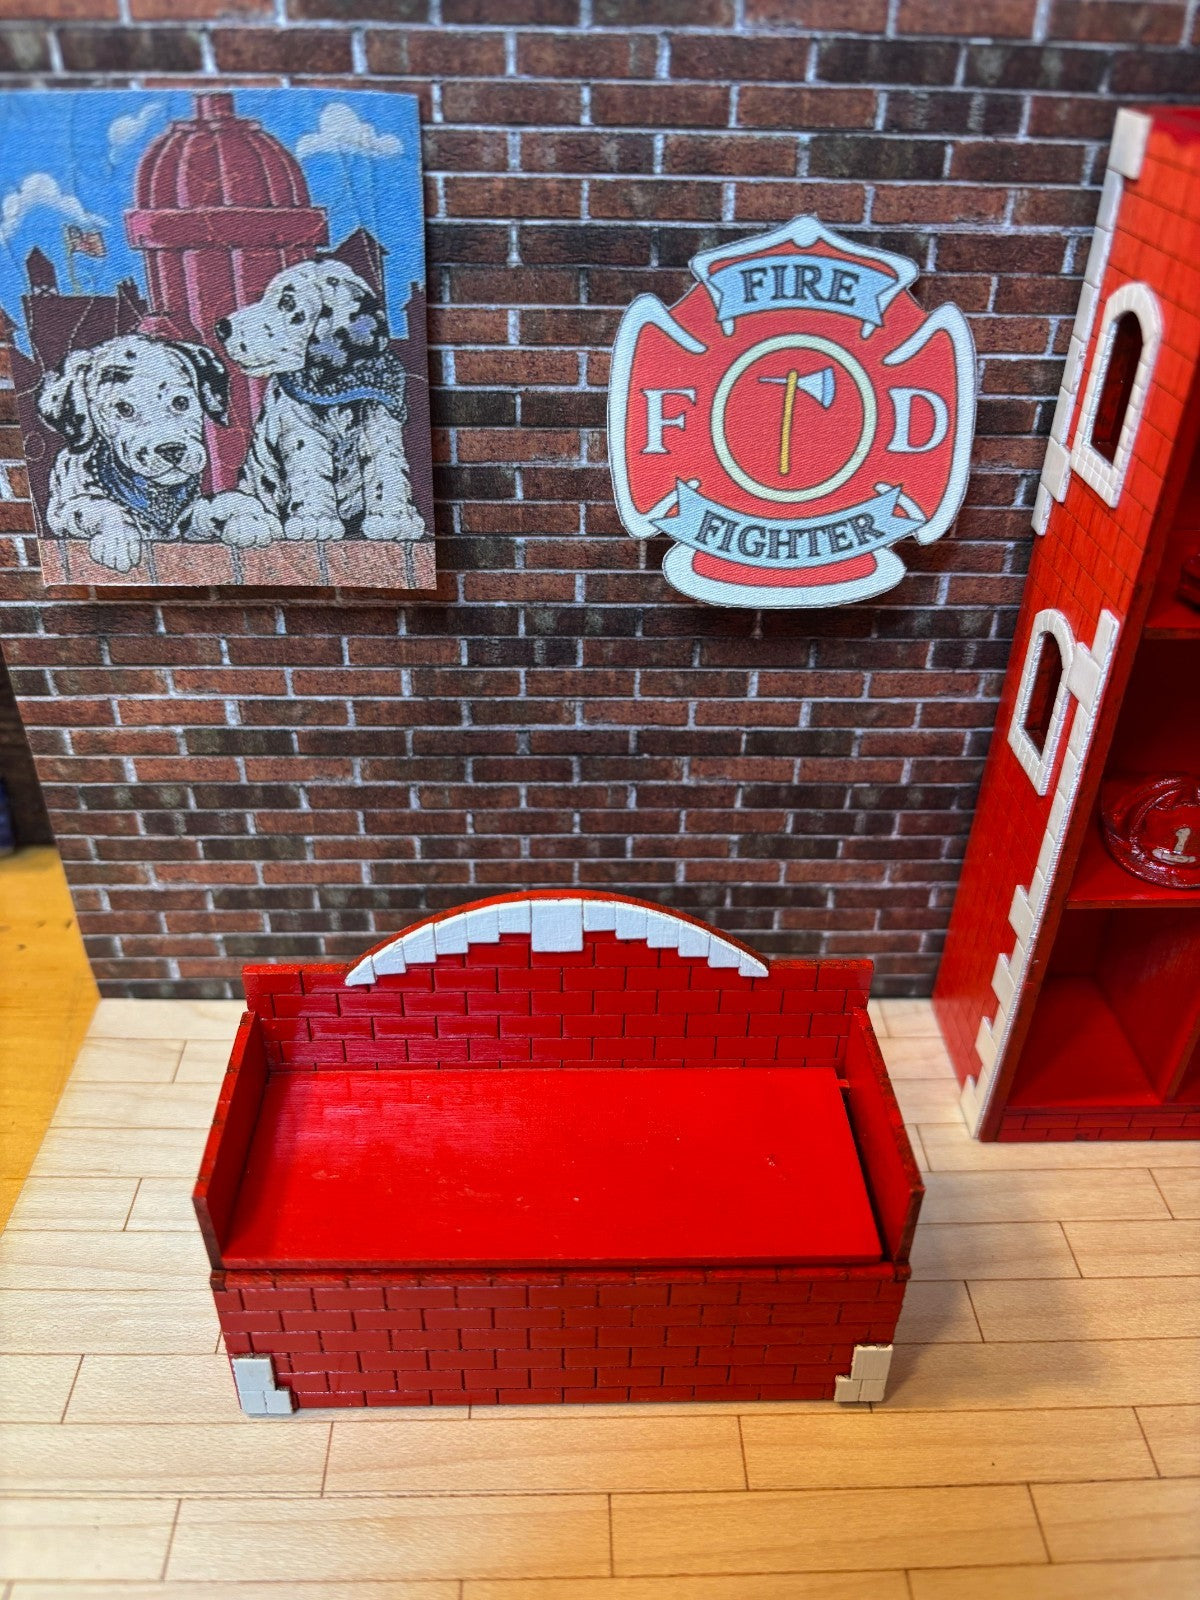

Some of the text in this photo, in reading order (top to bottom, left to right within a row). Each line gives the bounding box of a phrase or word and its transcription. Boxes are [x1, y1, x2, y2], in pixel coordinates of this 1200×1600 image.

[739, 264, 860, 306] FIRE
[641, 387, 950, 454] F D
[695, 510, 886, 560] FIGHTER
